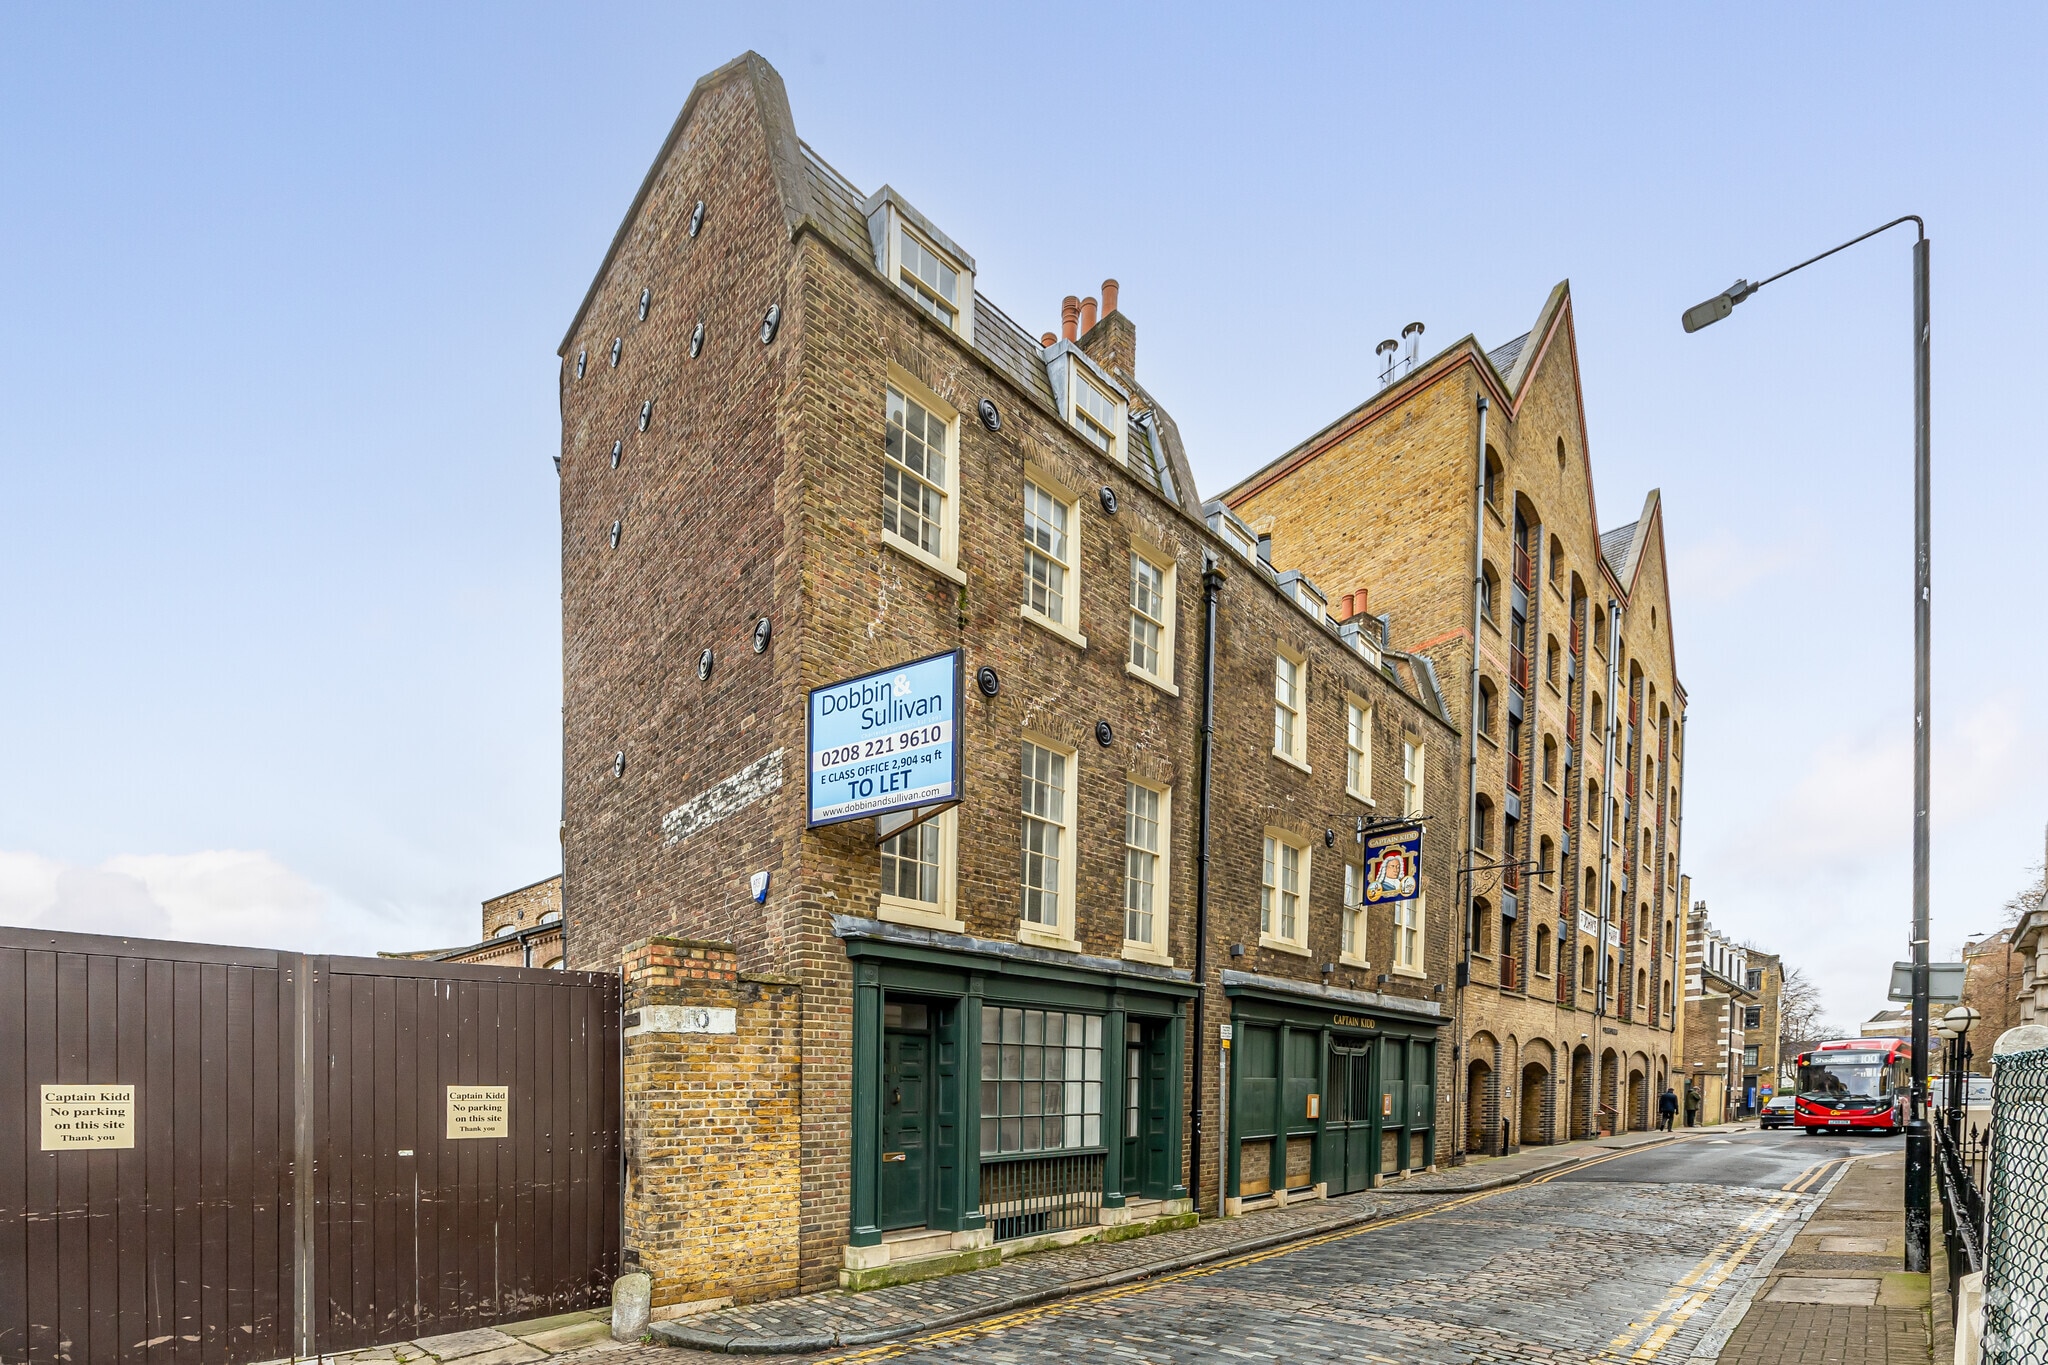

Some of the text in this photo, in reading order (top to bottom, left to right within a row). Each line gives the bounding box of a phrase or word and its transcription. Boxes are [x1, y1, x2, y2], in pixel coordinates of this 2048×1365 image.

[822, 673, 912, 716] Dobbin &
[861, 694, 942, 730] Sullivan
[821, 725, 941, 767] 0208 221 9610
[821, 749, 942, 785] E CLASS OFFICE 2,904 sq ft
[848, 769, 912, 800] TO LET
[822, 787, 940, 818] www.dobbinandsullivan.com
[1369, 832, 1417, 847] CAPTAIN KIDD
[1333, 1014, 1376, 1029] CAPTAIN KIDD
[1860, 1054, 1878, 1064] 100
[45, 1092, 130, 1104] Captain Kidd
[449, 1092, 483, 1101] Captain
[50, 1107, 126, 1118] No parking
[468, 1104, 502, 1112] parking
[75, 1121, 100, 1129] this
[103, 1121, 125, 1129] site
[60, 1134, 115, 1143] Thank you
